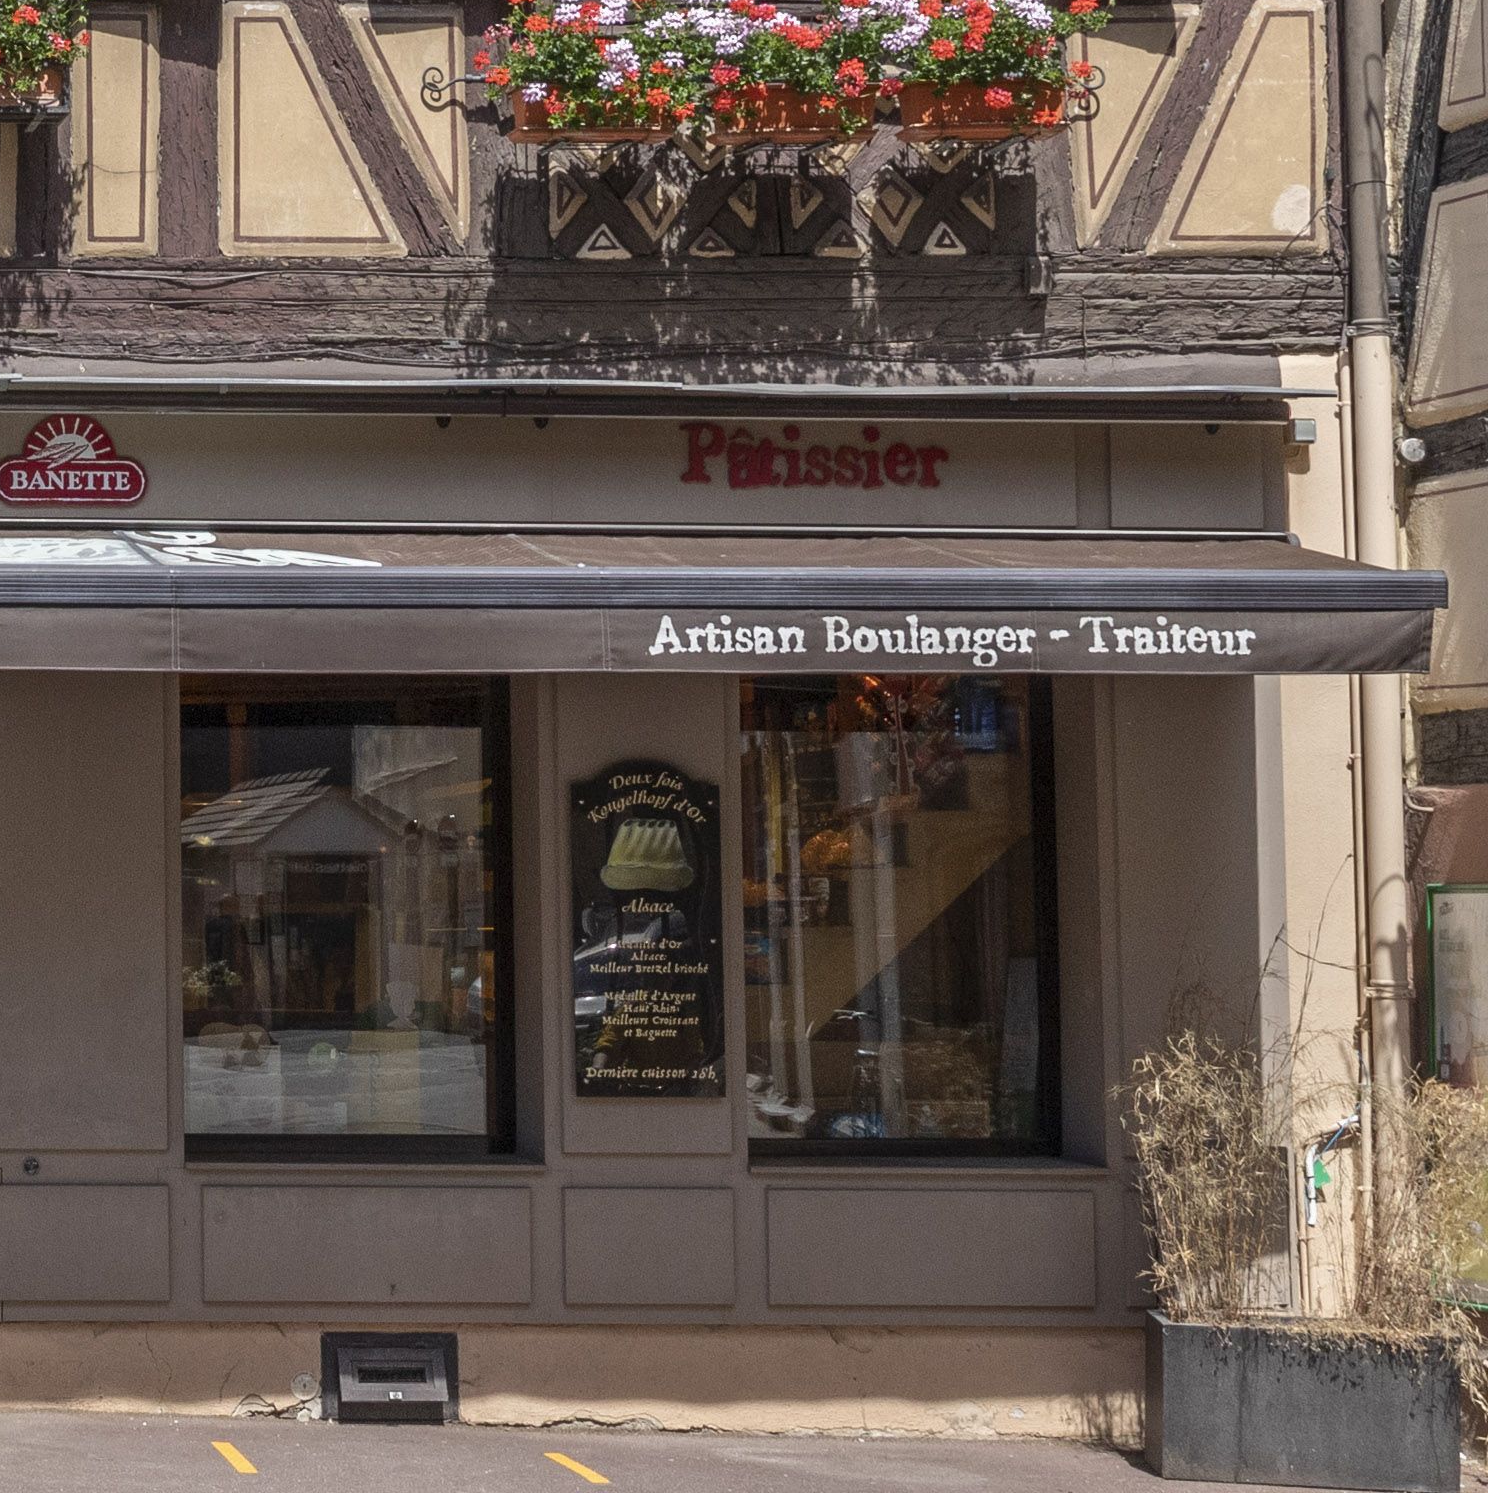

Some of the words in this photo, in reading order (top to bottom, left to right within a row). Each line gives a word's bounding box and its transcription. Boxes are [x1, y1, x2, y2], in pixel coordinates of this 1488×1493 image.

[679, 421, 950, 490] Pâtissier
[10, 470, 132, 491] BANETTE
[649, 614, 807, 656] Artisan
[824, 615, 1036, 667] Boulanger
[1080, 616, 1256, 656] Traiteur
[608, 773, 652, 789] Deux
[652, 772, 684, 790] fois
[587, 790, 676, 823] Kougelhopf
[674, 799, 707, 823] d'Or
[659, 938, 682, 949] d'Or
[590, 963, 632, 973] Meilleur
[635, 963, 671, 974] Bretzel
[651, 990, 696, 1004] d'Argent
[602, 1015, 648, 1025] Meilleurs
[652, 1016, 699, 1025] Croissant
[635, 1029, 677, 1041] Baguette
[585, 1067, 637, 1078] Dernière
[641, 1067, 686, 1078] cuisson
